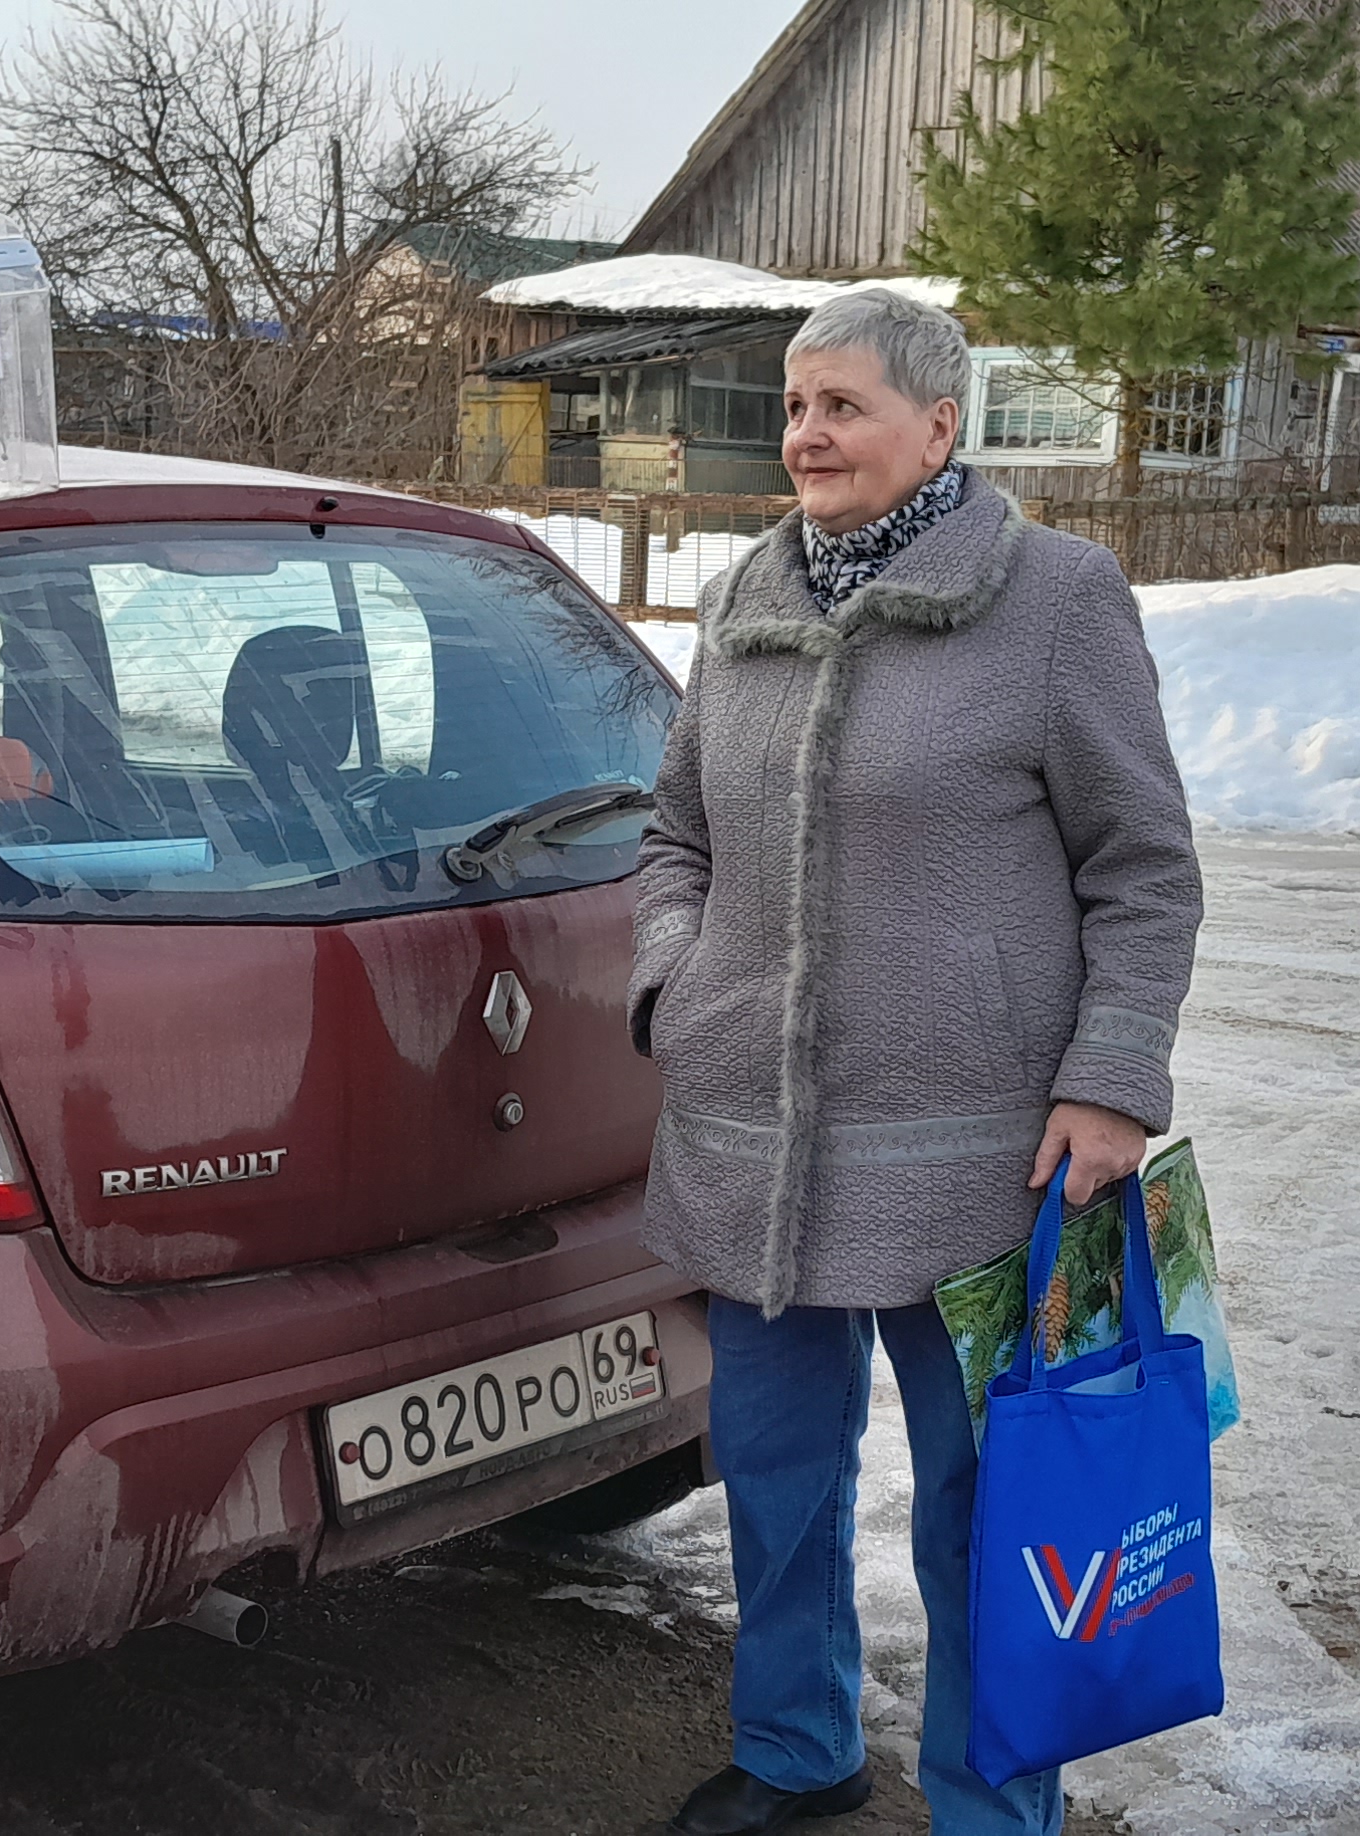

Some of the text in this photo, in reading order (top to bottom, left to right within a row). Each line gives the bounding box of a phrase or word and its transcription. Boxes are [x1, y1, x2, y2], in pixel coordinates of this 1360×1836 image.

[101, 1147, 288, 1198] RENAULT
[593, 1325, 638, 1384] 69
[594, 1383, 630, 1410] RUS
[1120, 1502, 1179, 1550] ЫБОРЫ
[1110, 1561, 1165, 1614] РОССИИ
